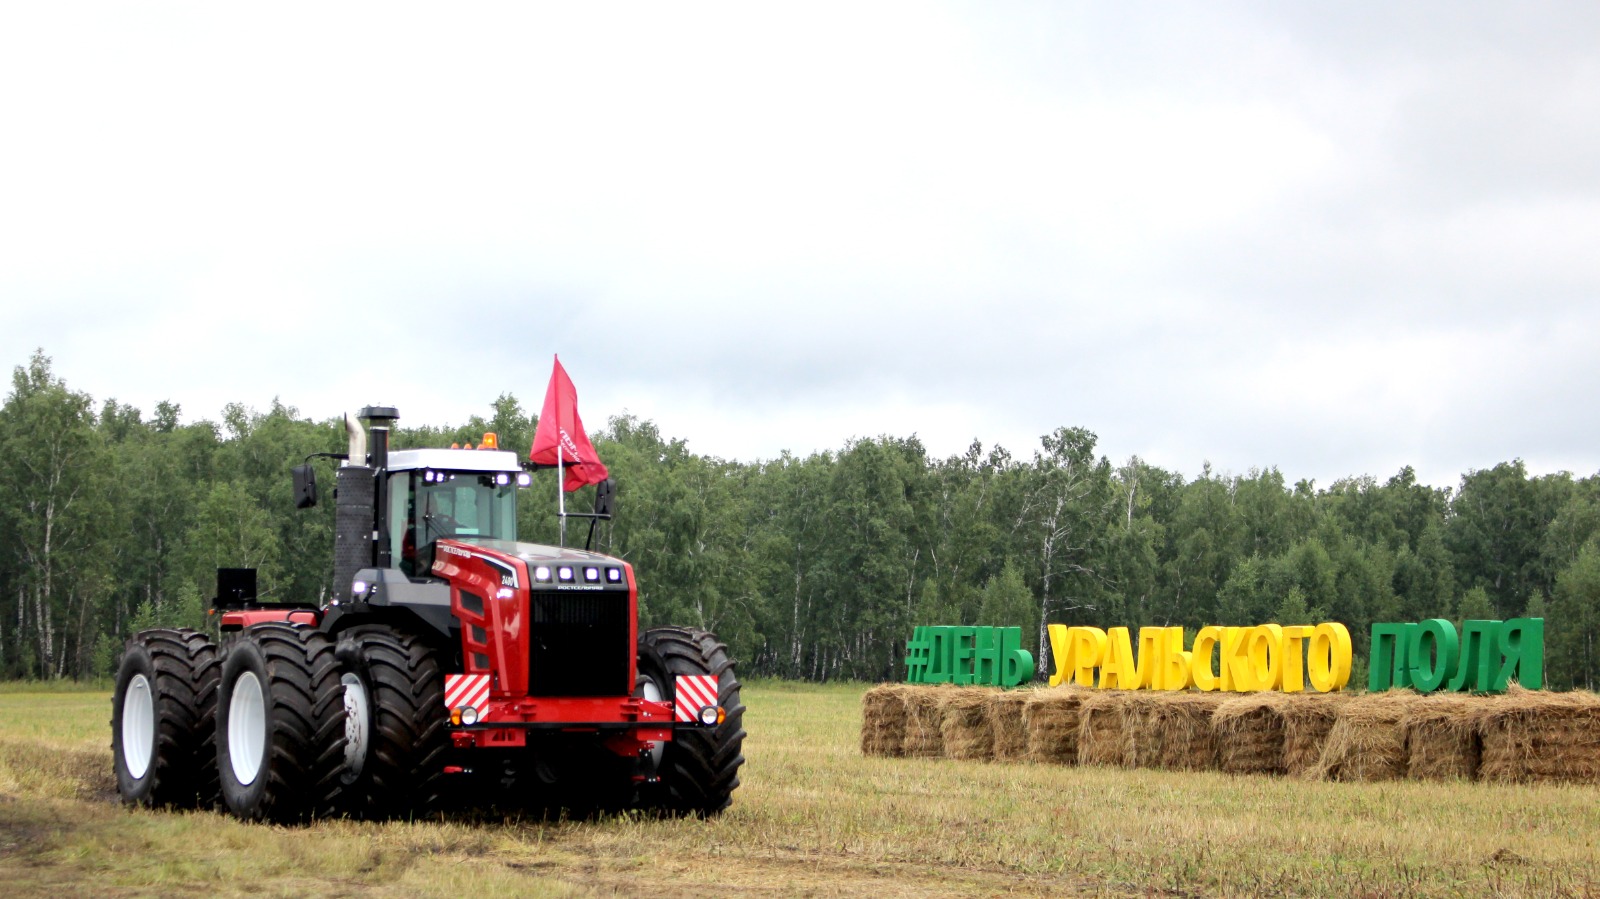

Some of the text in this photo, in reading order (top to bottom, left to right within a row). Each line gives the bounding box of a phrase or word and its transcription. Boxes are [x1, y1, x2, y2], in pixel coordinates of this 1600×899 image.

[905, 618, 1544, 692] #ДЕНЬ УРАЛЬСКОГО ПОЛЯ
